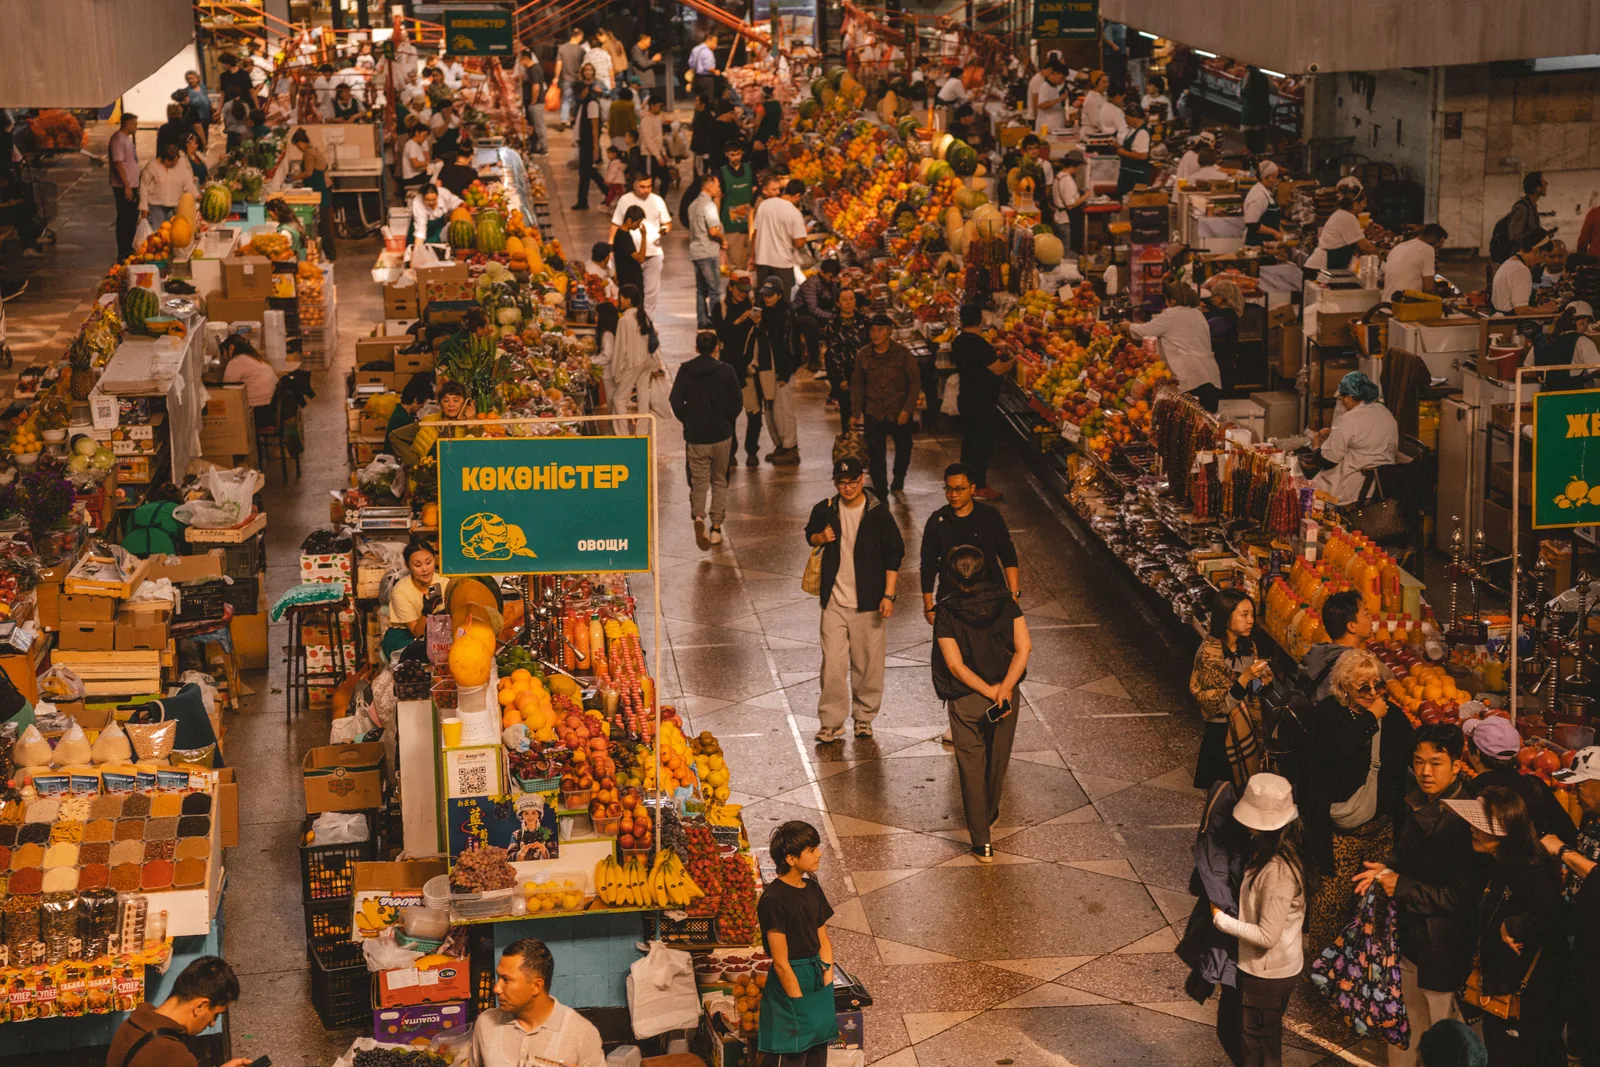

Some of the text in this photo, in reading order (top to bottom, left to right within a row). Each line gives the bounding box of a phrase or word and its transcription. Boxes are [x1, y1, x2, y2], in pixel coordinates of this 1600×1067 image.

[577, 539, 629, 552] ОВОЩИ
[117, 981, 140, 991] СУПЕР
[9, 991, 31, 1001] СУПЕР
[404, 1016, 440, 1026] ECUALITTA
